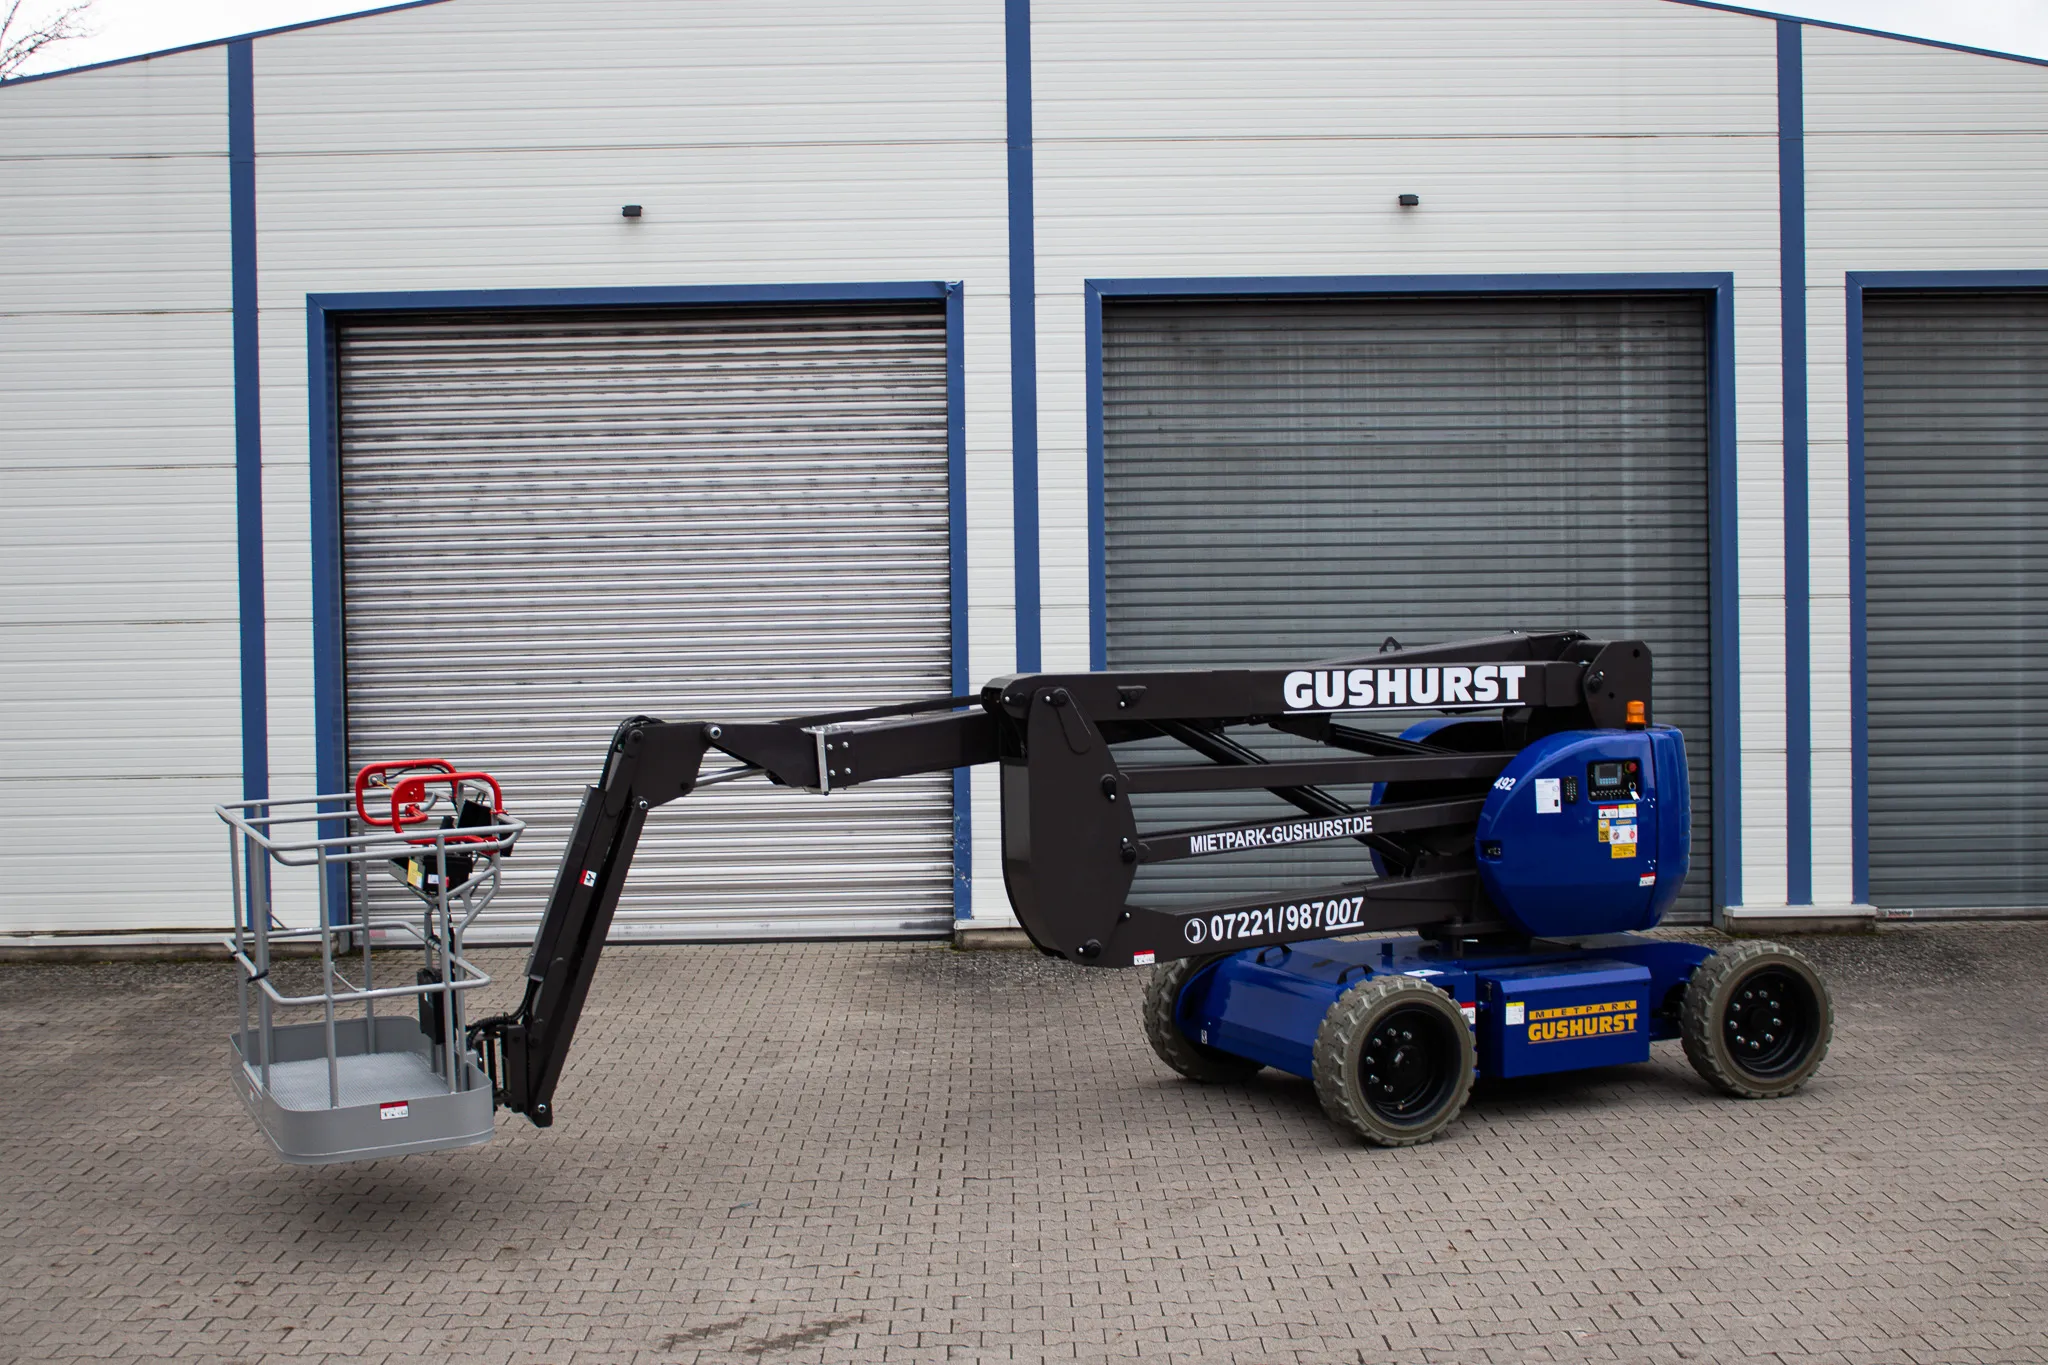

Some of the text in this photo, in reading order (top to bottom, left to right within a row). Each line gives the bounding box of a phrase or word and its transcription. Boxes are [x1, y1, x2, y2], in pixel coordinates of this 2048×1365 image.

[1283, 665, 1526, 709] GUSHURST
[1493, 776, 1517, 791] 492
[1190, 815, 1373, 854] MIETPARK-GUSHURST.DE
[1210, 896, 1364, 941] 07221/987007
[1535, 1001, 1632, 1018] MIETPARK
[1528, 1013, 1638, 1041] GUSHURST
